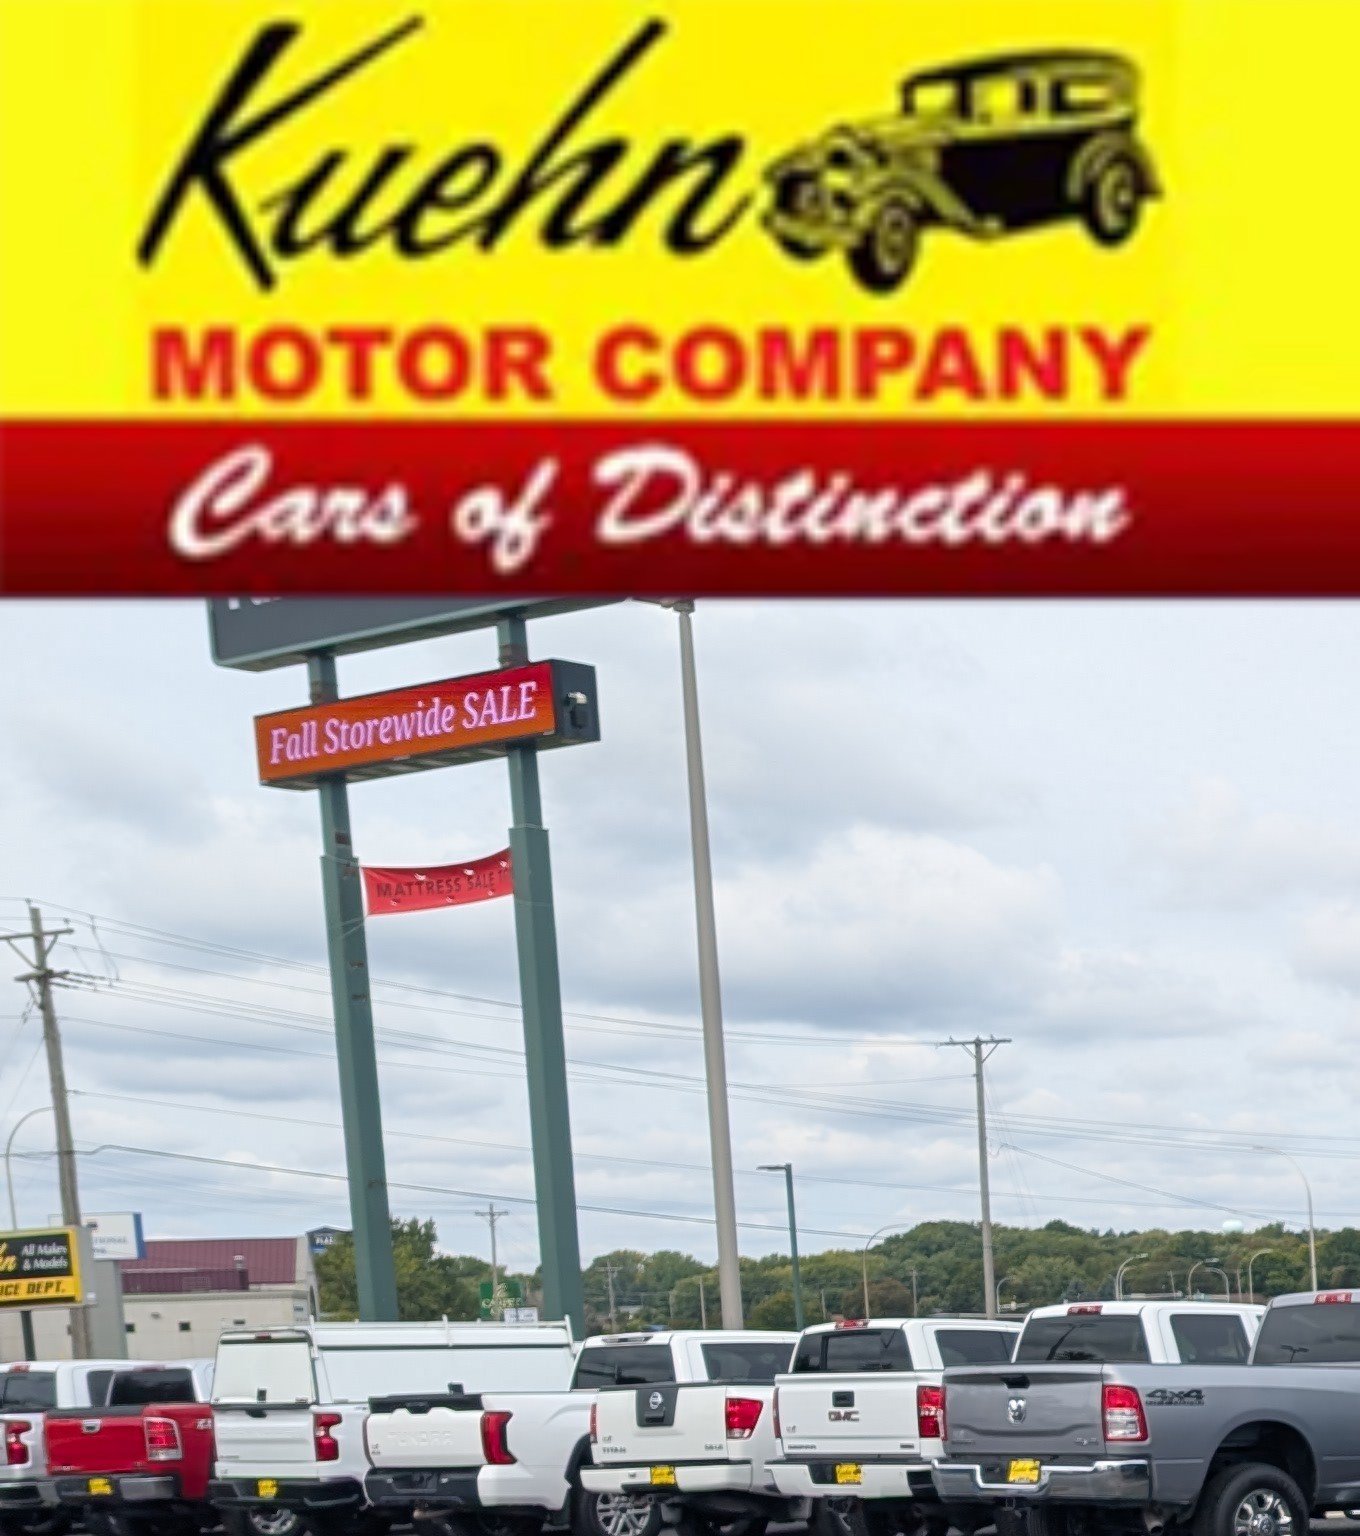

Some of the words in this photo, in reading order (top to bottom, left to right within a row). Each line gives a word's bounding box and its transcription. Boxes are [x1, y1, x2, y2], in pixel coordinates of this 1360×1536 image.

[269, 720, 318, 765] Fall
[323, 697, 455, 755] Storewide
[462, 680, 538, 730] SALE
[376, 877, 462, 898] MATTRESS
[466, 871, 495, 891] SALE
[22, 1243, 35, 1257] All
[37, 1241, 68, 1256] Makes
[33, 1255, 69, 1270] Models
[26, 1280, 66, 1295] DEPT.
[828, 1410, 860, 1422] GMC
